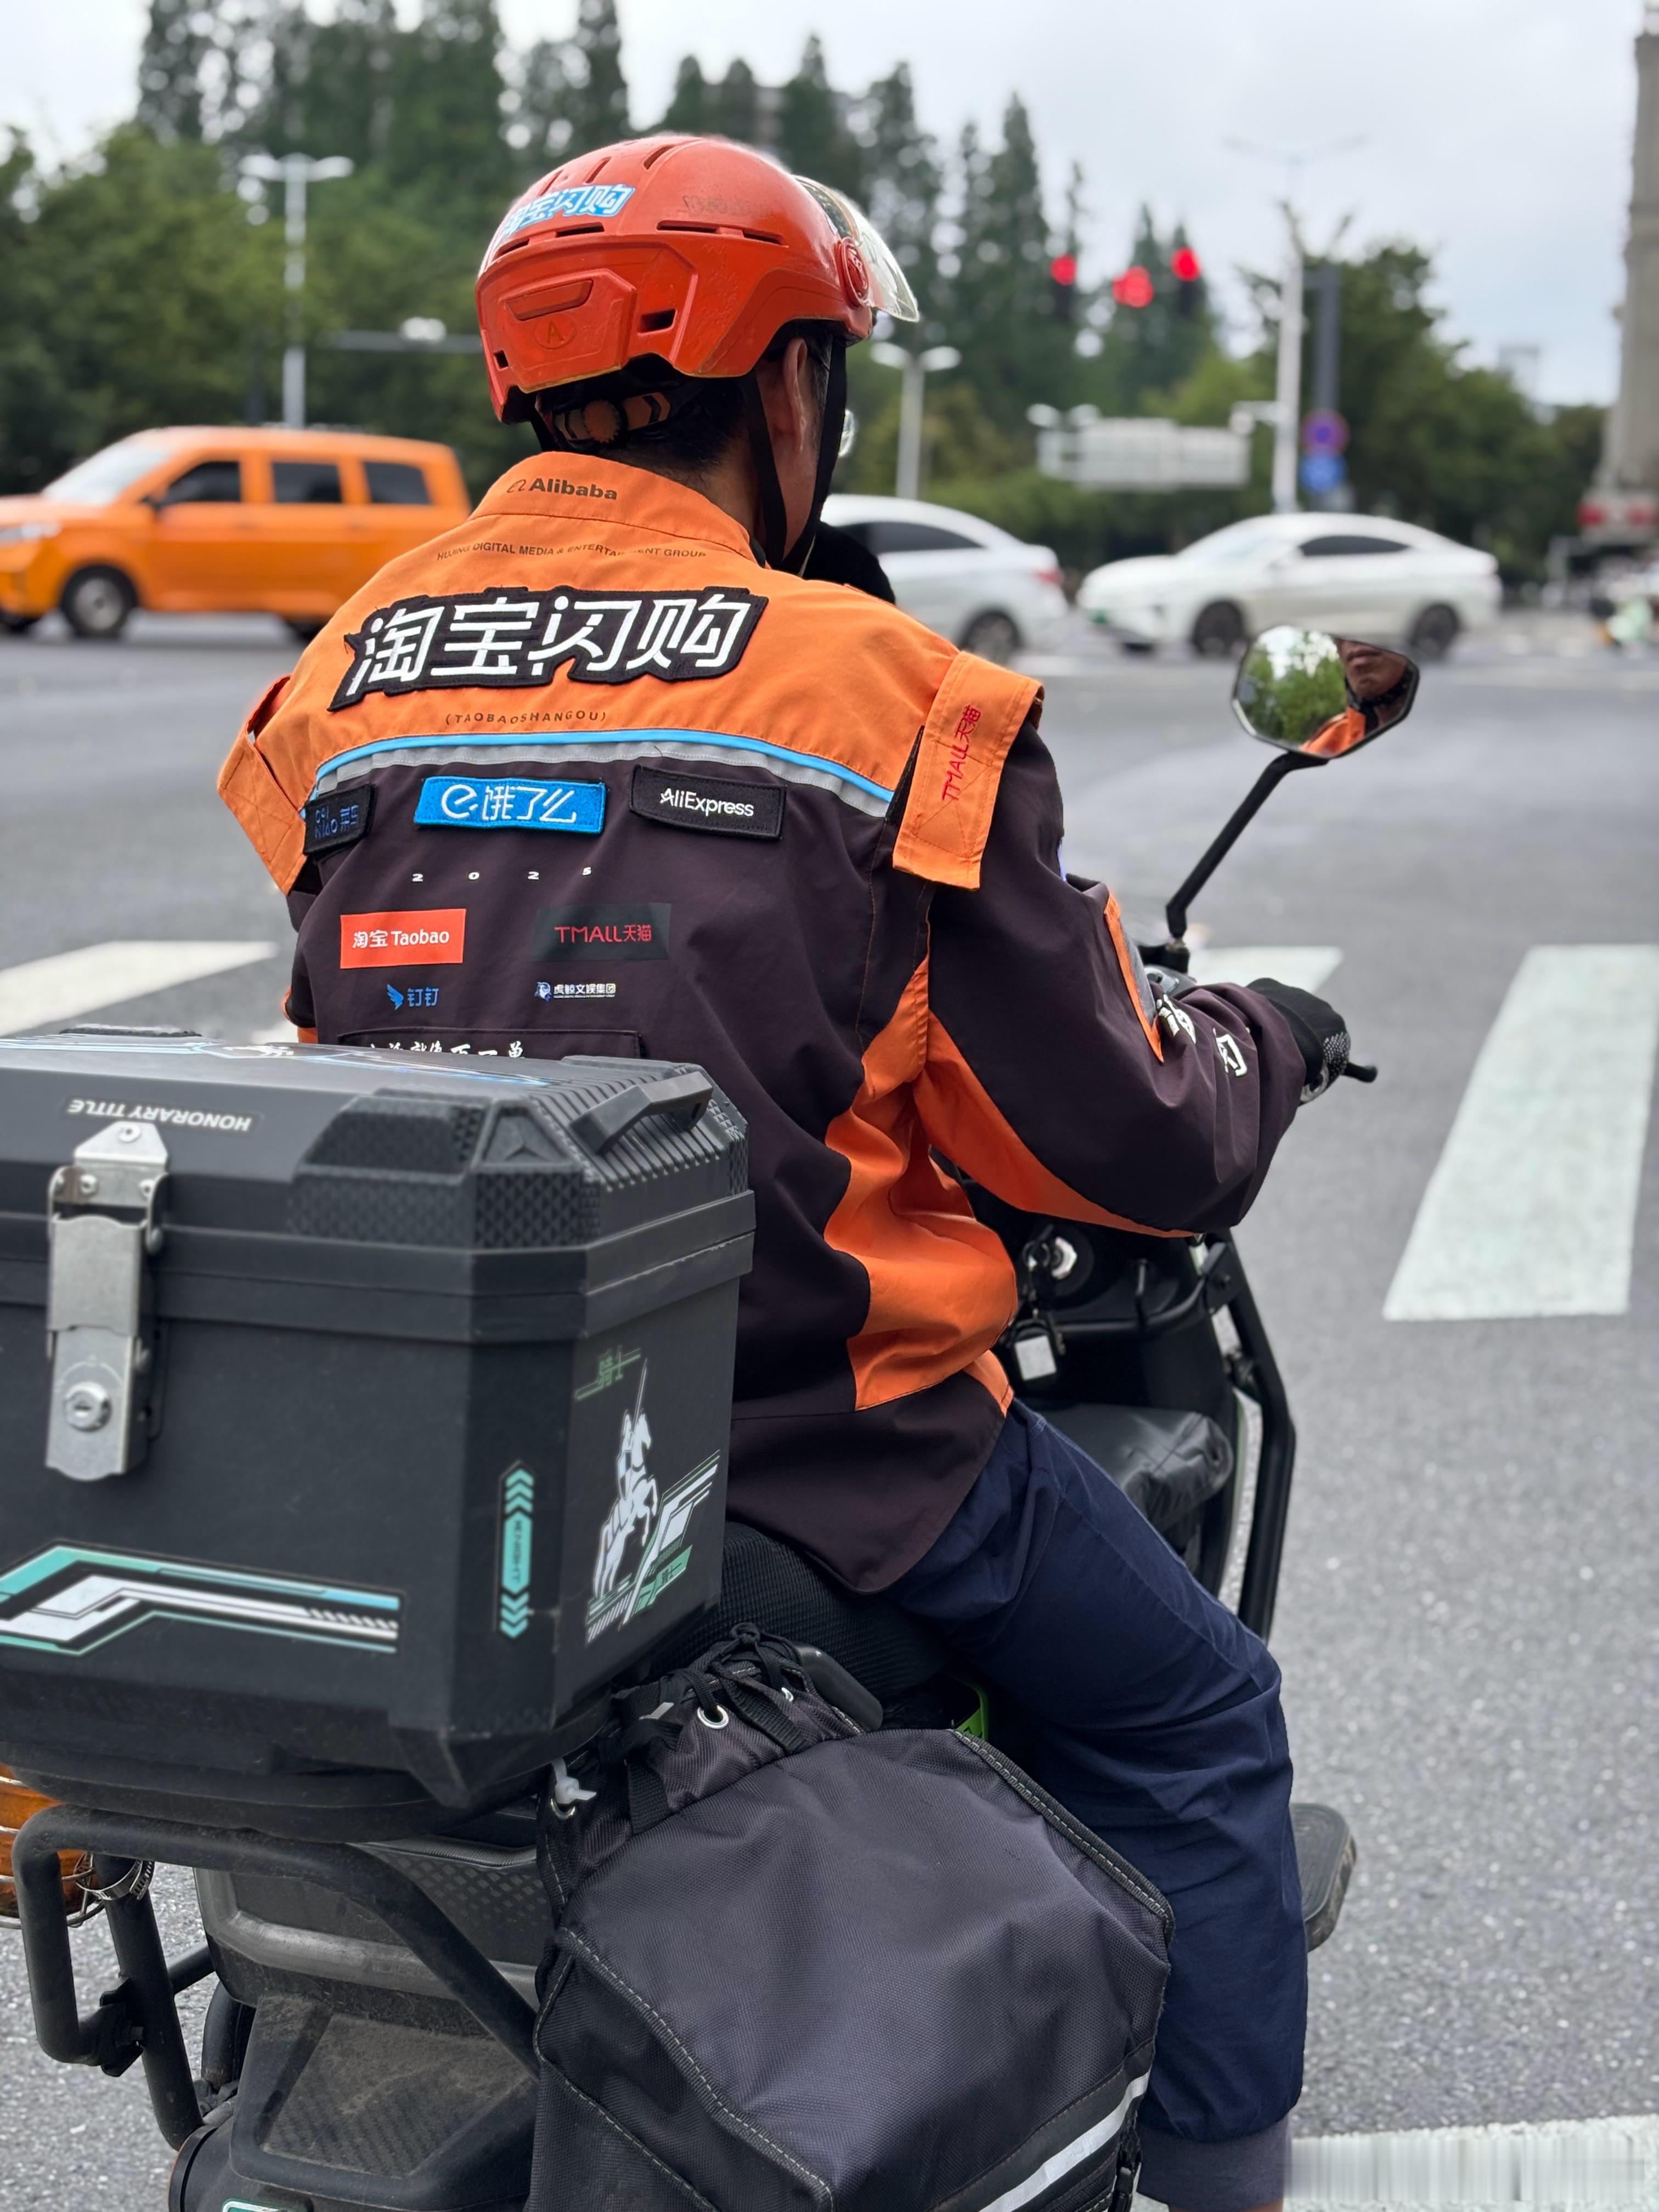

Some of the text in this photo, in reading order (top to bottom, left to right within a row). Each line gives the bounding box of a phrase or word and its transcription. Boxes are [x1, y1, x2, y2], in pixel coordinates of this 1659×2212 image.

[528, 478, 617, 500] Alibaba
[473, 543, 515, 554] DIGITAL
[519, 546, 554, 555] MEDIA
[663, 549, 706, 557] GROUP
[347, 595, 752, 697] 淘宝闪购
[660, 788, 754, 817] AliExpress
[352, 929, 449, 949] 淘宝 Taobao
[407, 987, 439, 1007] 钉钉
[68, 1099, 251, 1131] HONORARY TITLE
